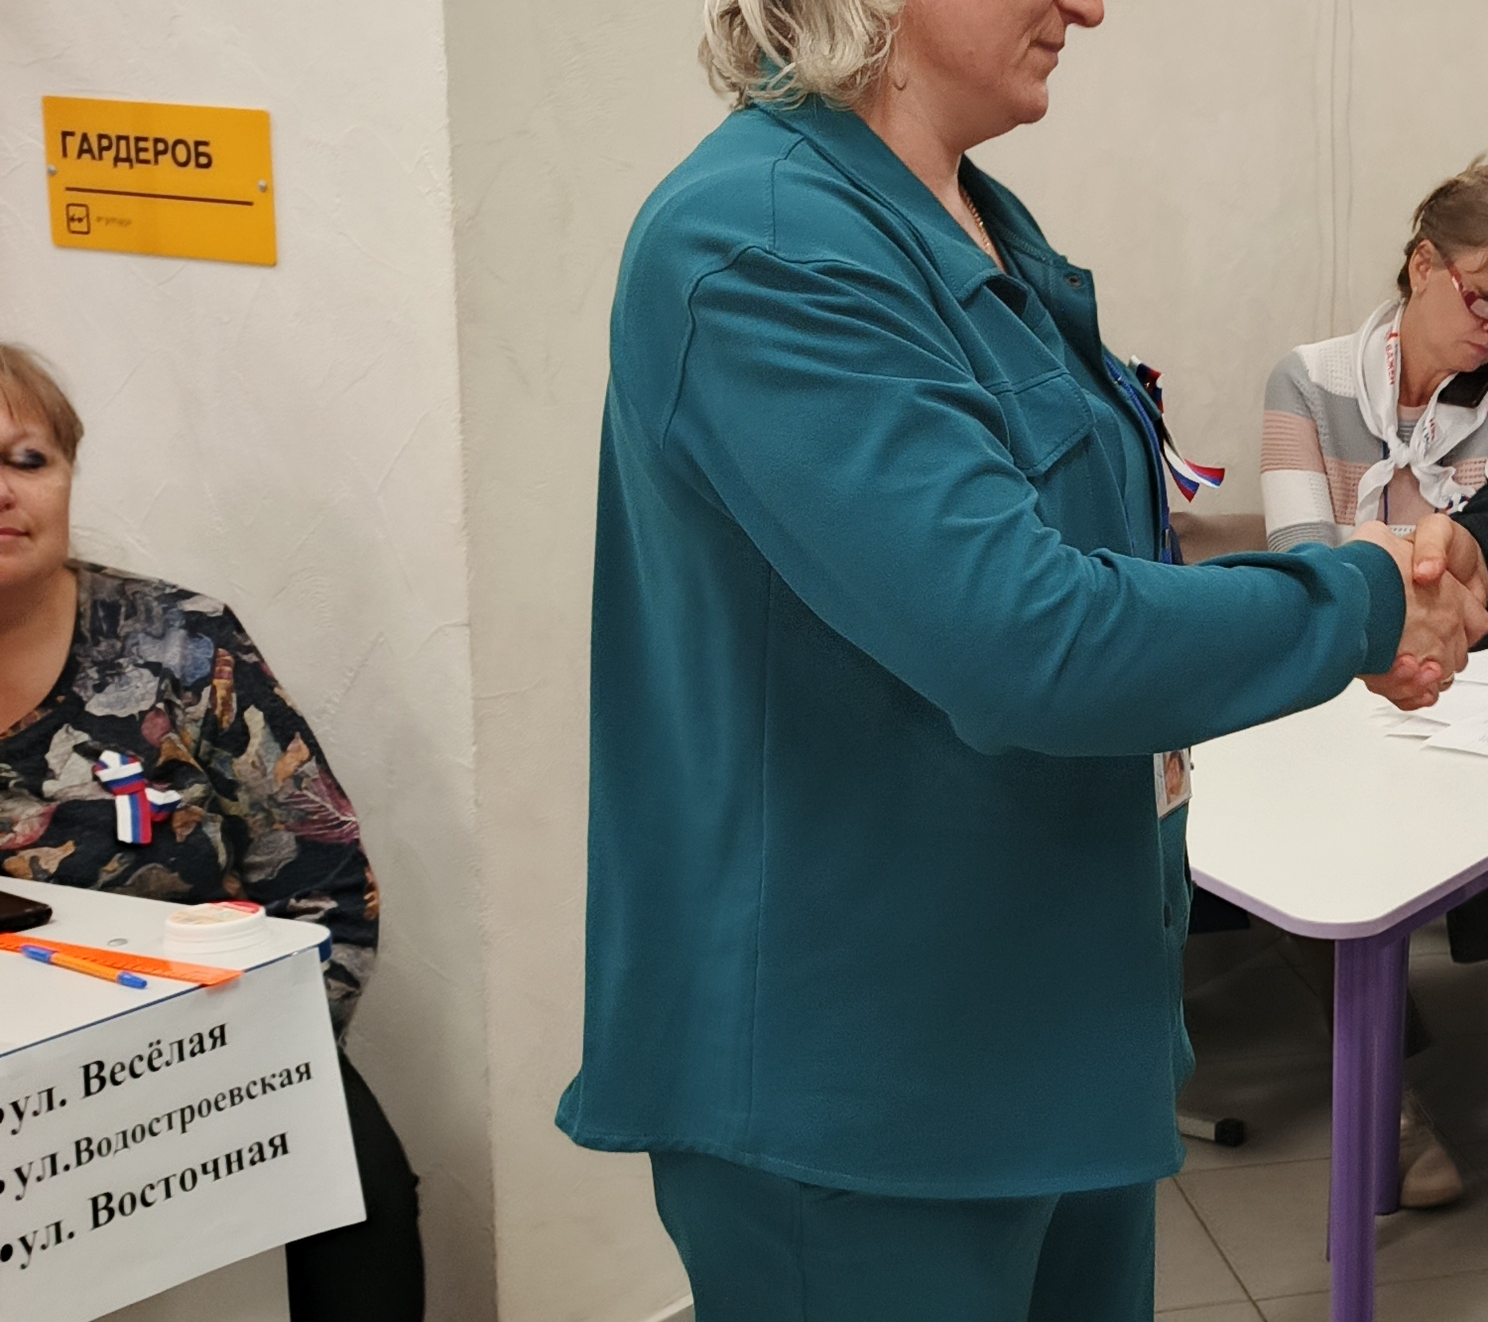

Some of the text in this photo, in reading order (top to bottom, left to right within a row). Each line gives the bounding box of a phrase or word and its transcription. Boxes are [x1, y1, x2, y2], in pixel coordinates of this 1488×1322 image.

[60, 131, 213, 169] ГАРДЕРОБ
[9, 1022, 230, 1136] ул. Весёлая
[18, 1131, 290, 1270] ул. Восточная
